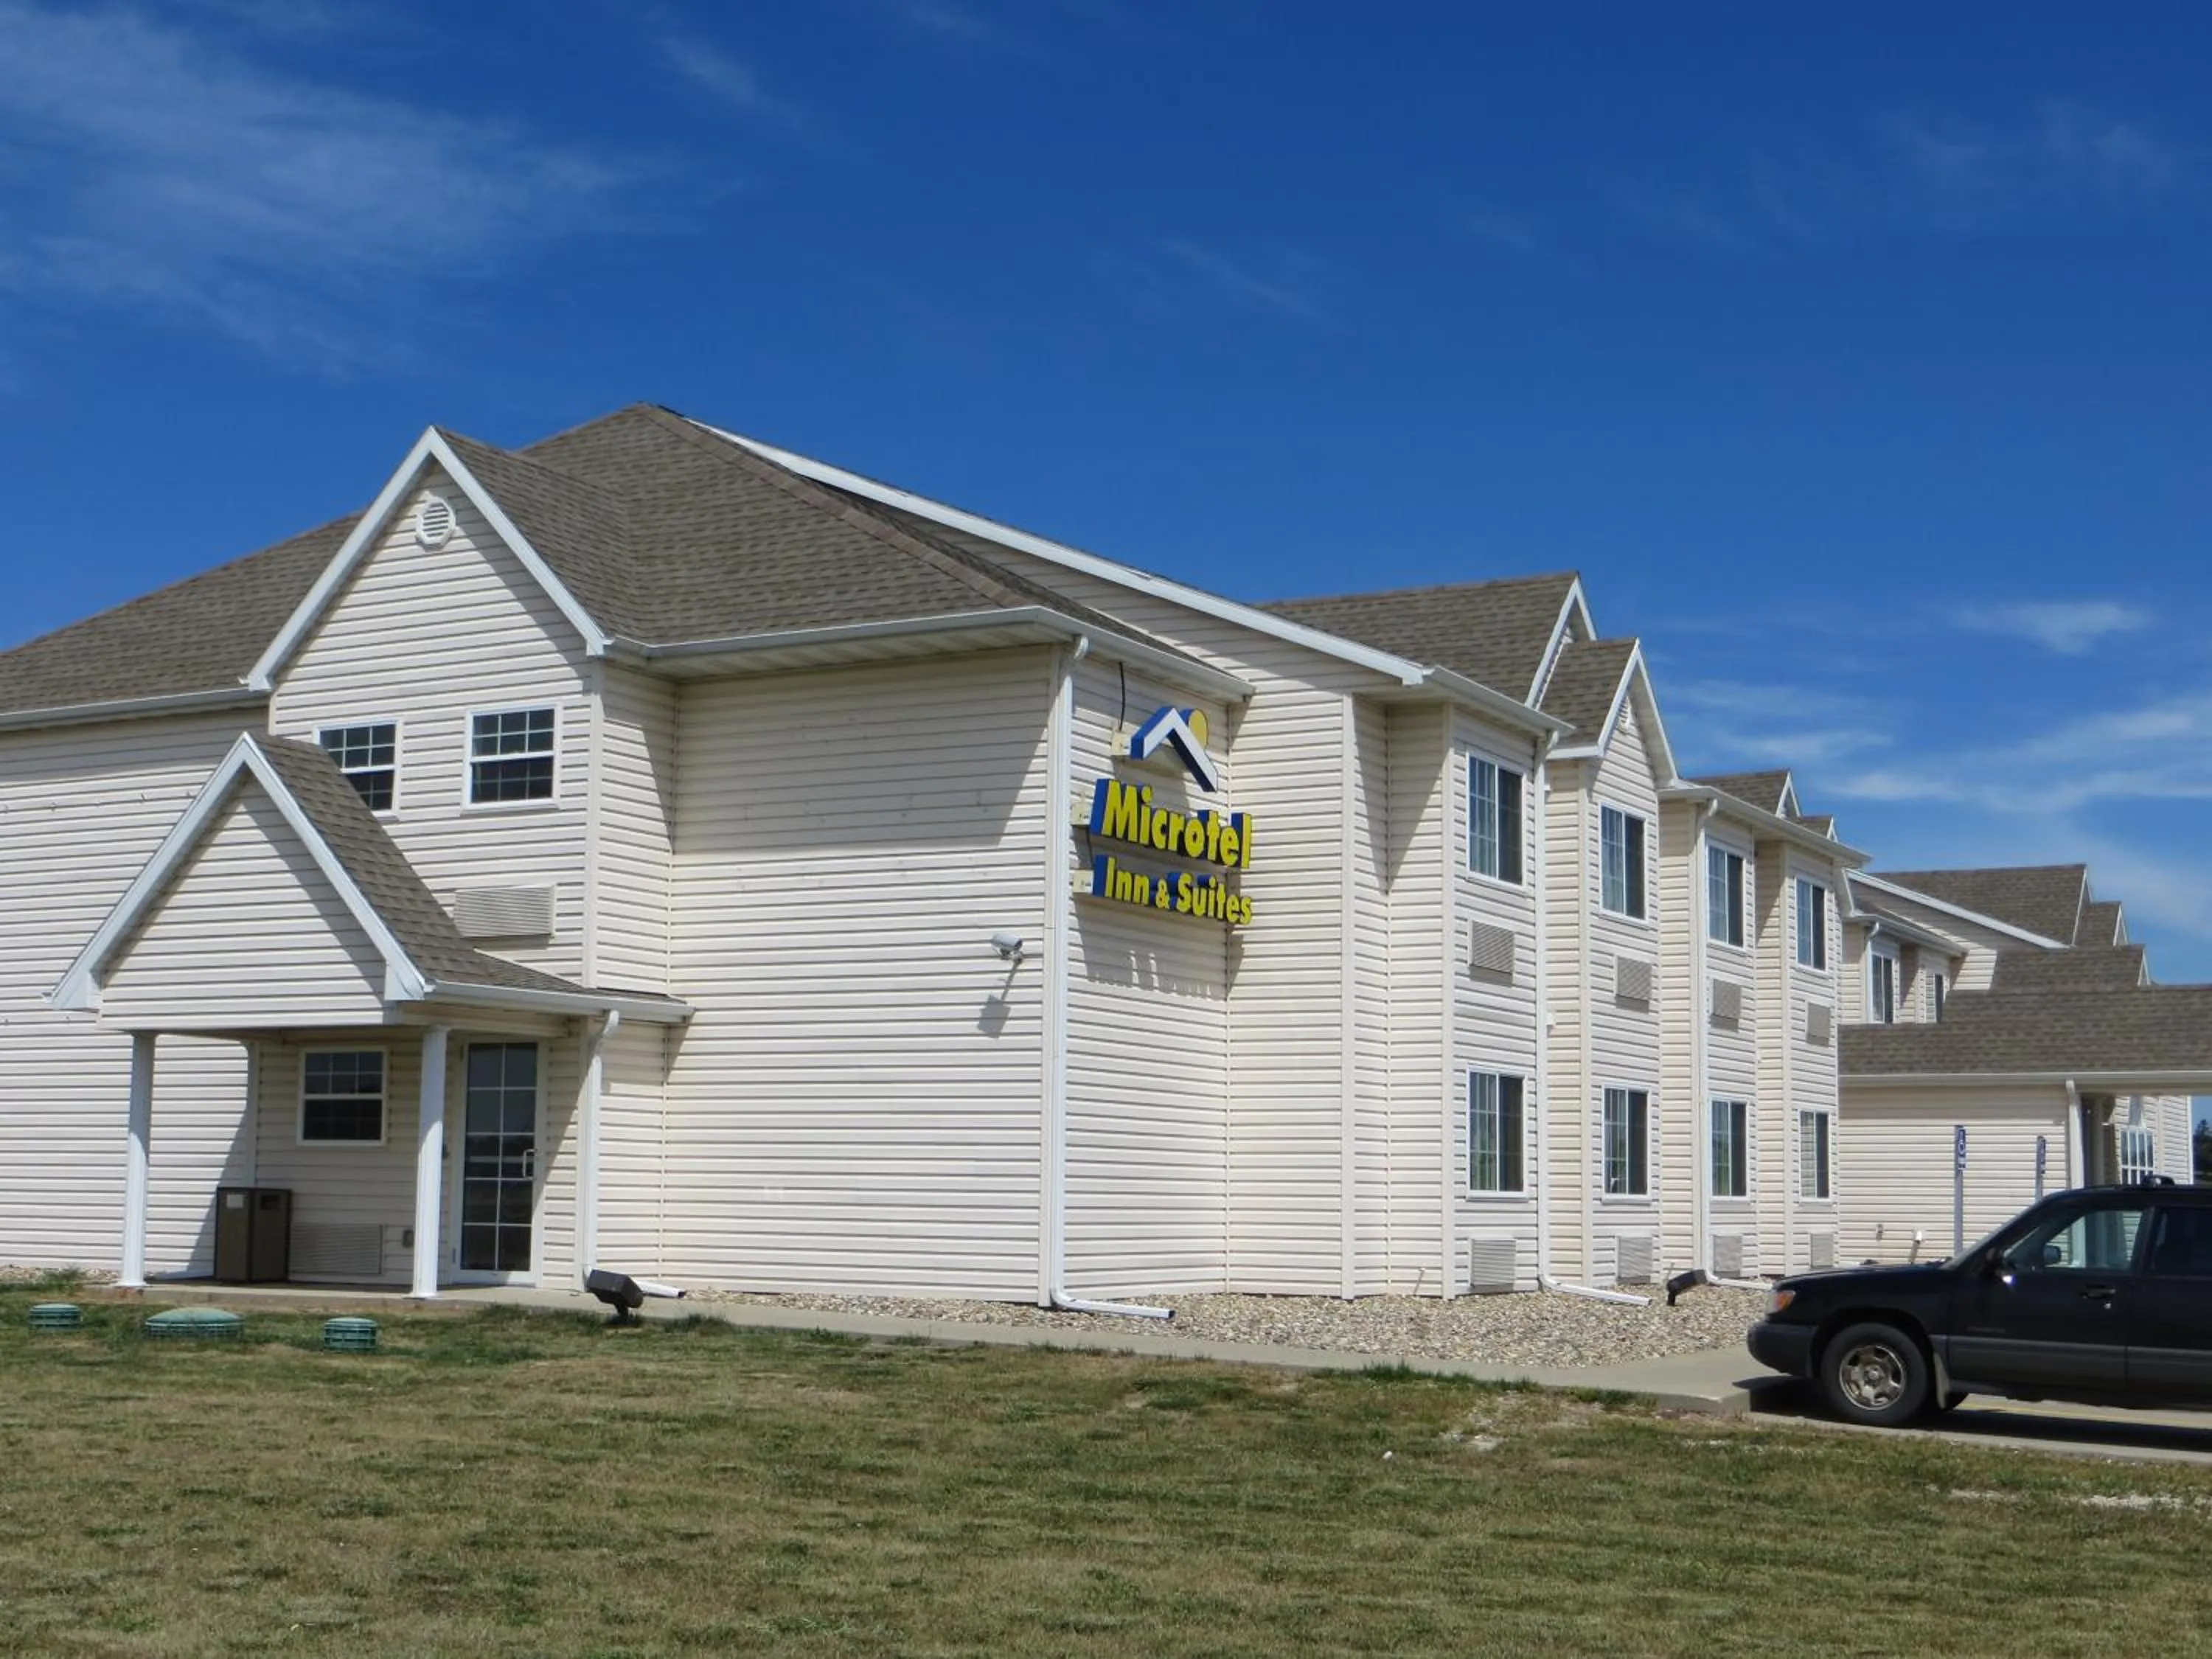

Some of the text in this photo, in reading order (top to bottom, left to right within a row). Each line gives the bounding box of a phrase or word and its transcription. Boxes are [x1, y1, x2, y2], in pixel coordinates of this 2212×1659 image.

[1101, 779, 1252, 869] Microtel
[1105, 855, 1252, 924] Inn & Suites
